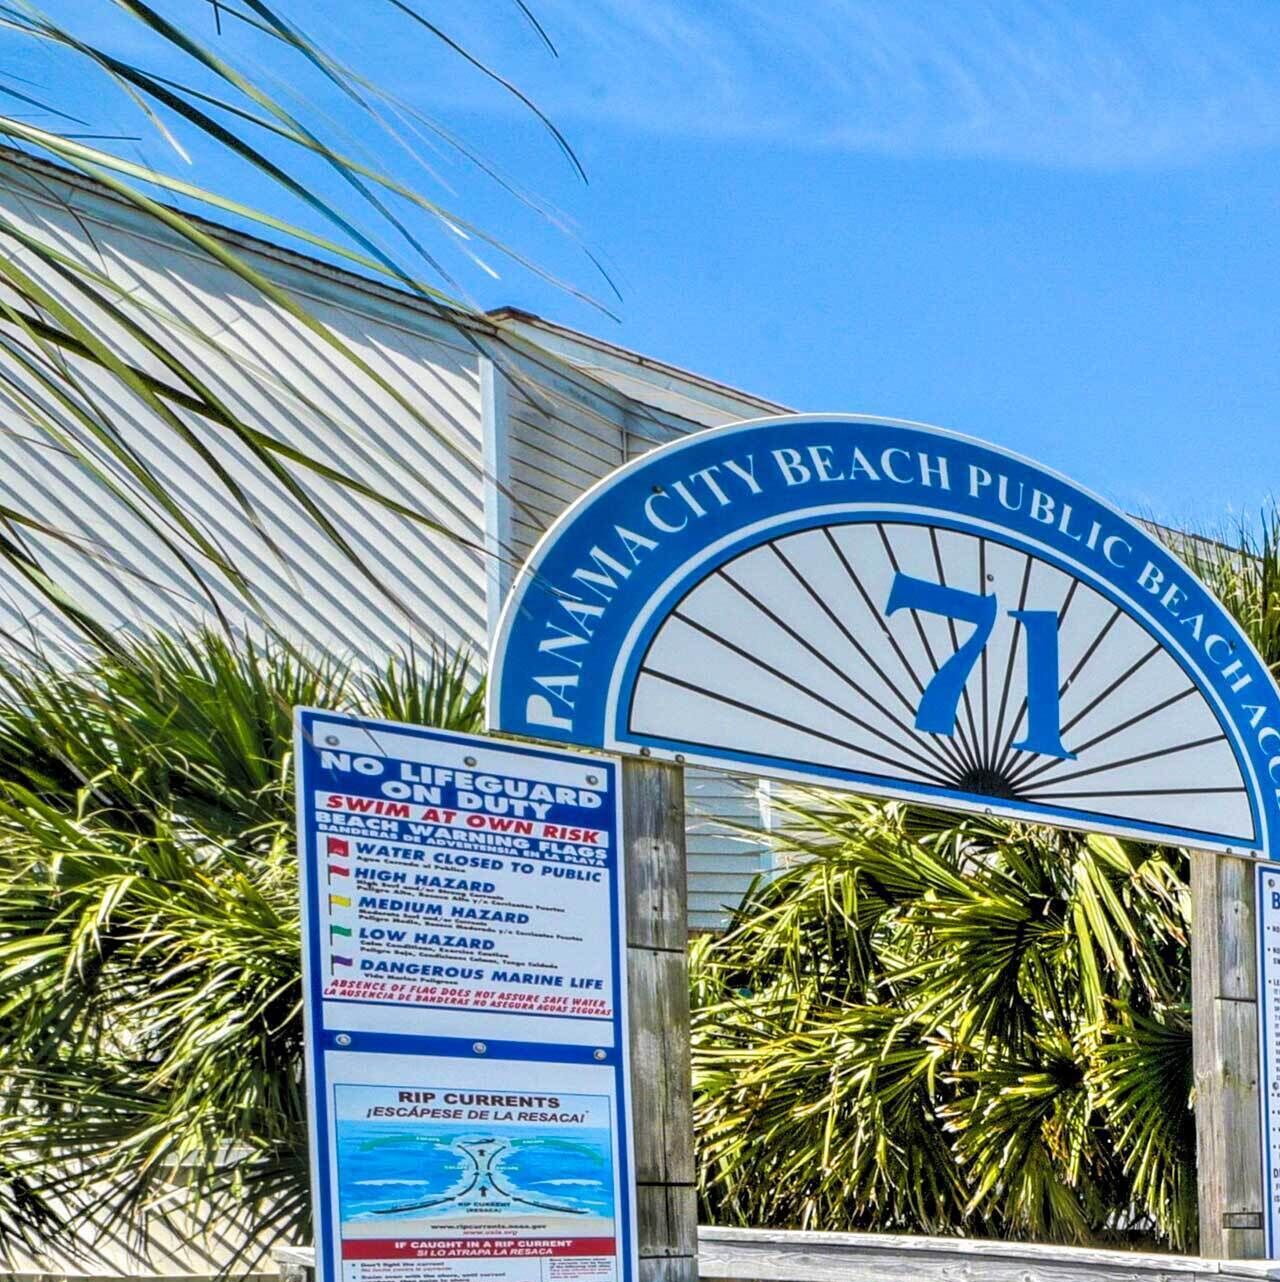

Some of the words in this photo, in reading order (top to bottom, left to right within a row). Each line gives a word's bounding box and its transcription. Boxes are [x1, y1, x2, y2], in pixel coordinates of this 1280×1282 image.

[526, 525, 660, 733] PANAMA
[644, 454, 764, 533] CITY
[771, 445, 951, 491] BEACH
[968, 464, 1132, 569] PUBLIC
[1136, 560, 1253, 694] BEACH
[885, 571, 1078, 761] 71
[320, 751, 384, 775] NO
[400, 762, 602, 808] LIFEGUARD
[381, 780, 441, 804] ON
[457, 791, 552, 820] DUTY
[315, 811, 398, 832] BEACH
[408, 823, 530, 849] WARNING
[539, 842, 607, 859] FLAGS
[327, 795, 410, 818] SWIM
[422, 808, 456, 824] AT
[466, 815, 533, 835] OWN
[543, 824, 600, 844] RISK
[318, 824, 398, 840] BANDERAS
[403, 834, 421, 843] DE
[426, 838, 518, 856] ADVERTENSIA
[523, 850, 539, 859] EN
[545, 852, 560, 861] LA
[564, 855, 604, 867] PLAYA
[356, 843, 425, 861] WATER
[433, 853, 503, 870] CLOSED
[511, 862, 534, 874] TO
[541, 866, 601, 883] PUBLIC
[355, 868, 407, 883] HIGH
[415, 874, 495, 893] HAZARD
[358, 897, 443, 915] MEDIUM
[451, 906, 529, 924] HAZARD
[359, 927, 407, 942] LOW
[414, 933, 495, 950] HAZARD
[360, 959, 484, 980] DANGEROUS
[491, 971, 563, 987] MARINE
[570, 978, 603, 990] LIFE
[331, 979, 385, 991] ABSENCE
[391, 983, 407, 992] OF
[410, 985, 436, 994] FLAG
[441, 987, 471, 997] DOES
[474, 991, 496, 999] NOT
[498, 992, 540, 1002] ASSURE
[543, 996, 568, 1005] SAFE
[573, 998, 606, 1008] WATER
[342, 989, 393, 1000] AUSENCIA
[398, 993, 411, 1001] DE
[416, 995, 469, 1005] BANDERAS
[491, 1001, 534, 1010] ASEGURA
[537, 1003, 568, 1013] AGUAS
[367, 1106, 462, 1120] ¡ESCÁPESE
[467, 1110, 489, 1120] DE
[493, 1111, 514, 1121] LA
[517, 1112, 585, 1123] RESACA!
[398, 1091, 436, 1104] RIP
[443, 1093, 560, 1109] CURRENTS
[410, 1241, 462, 1249] CAUGHT
[466, 1241, 479, 1249] IN
[518, 1240, 572, 1248] CURRENT
